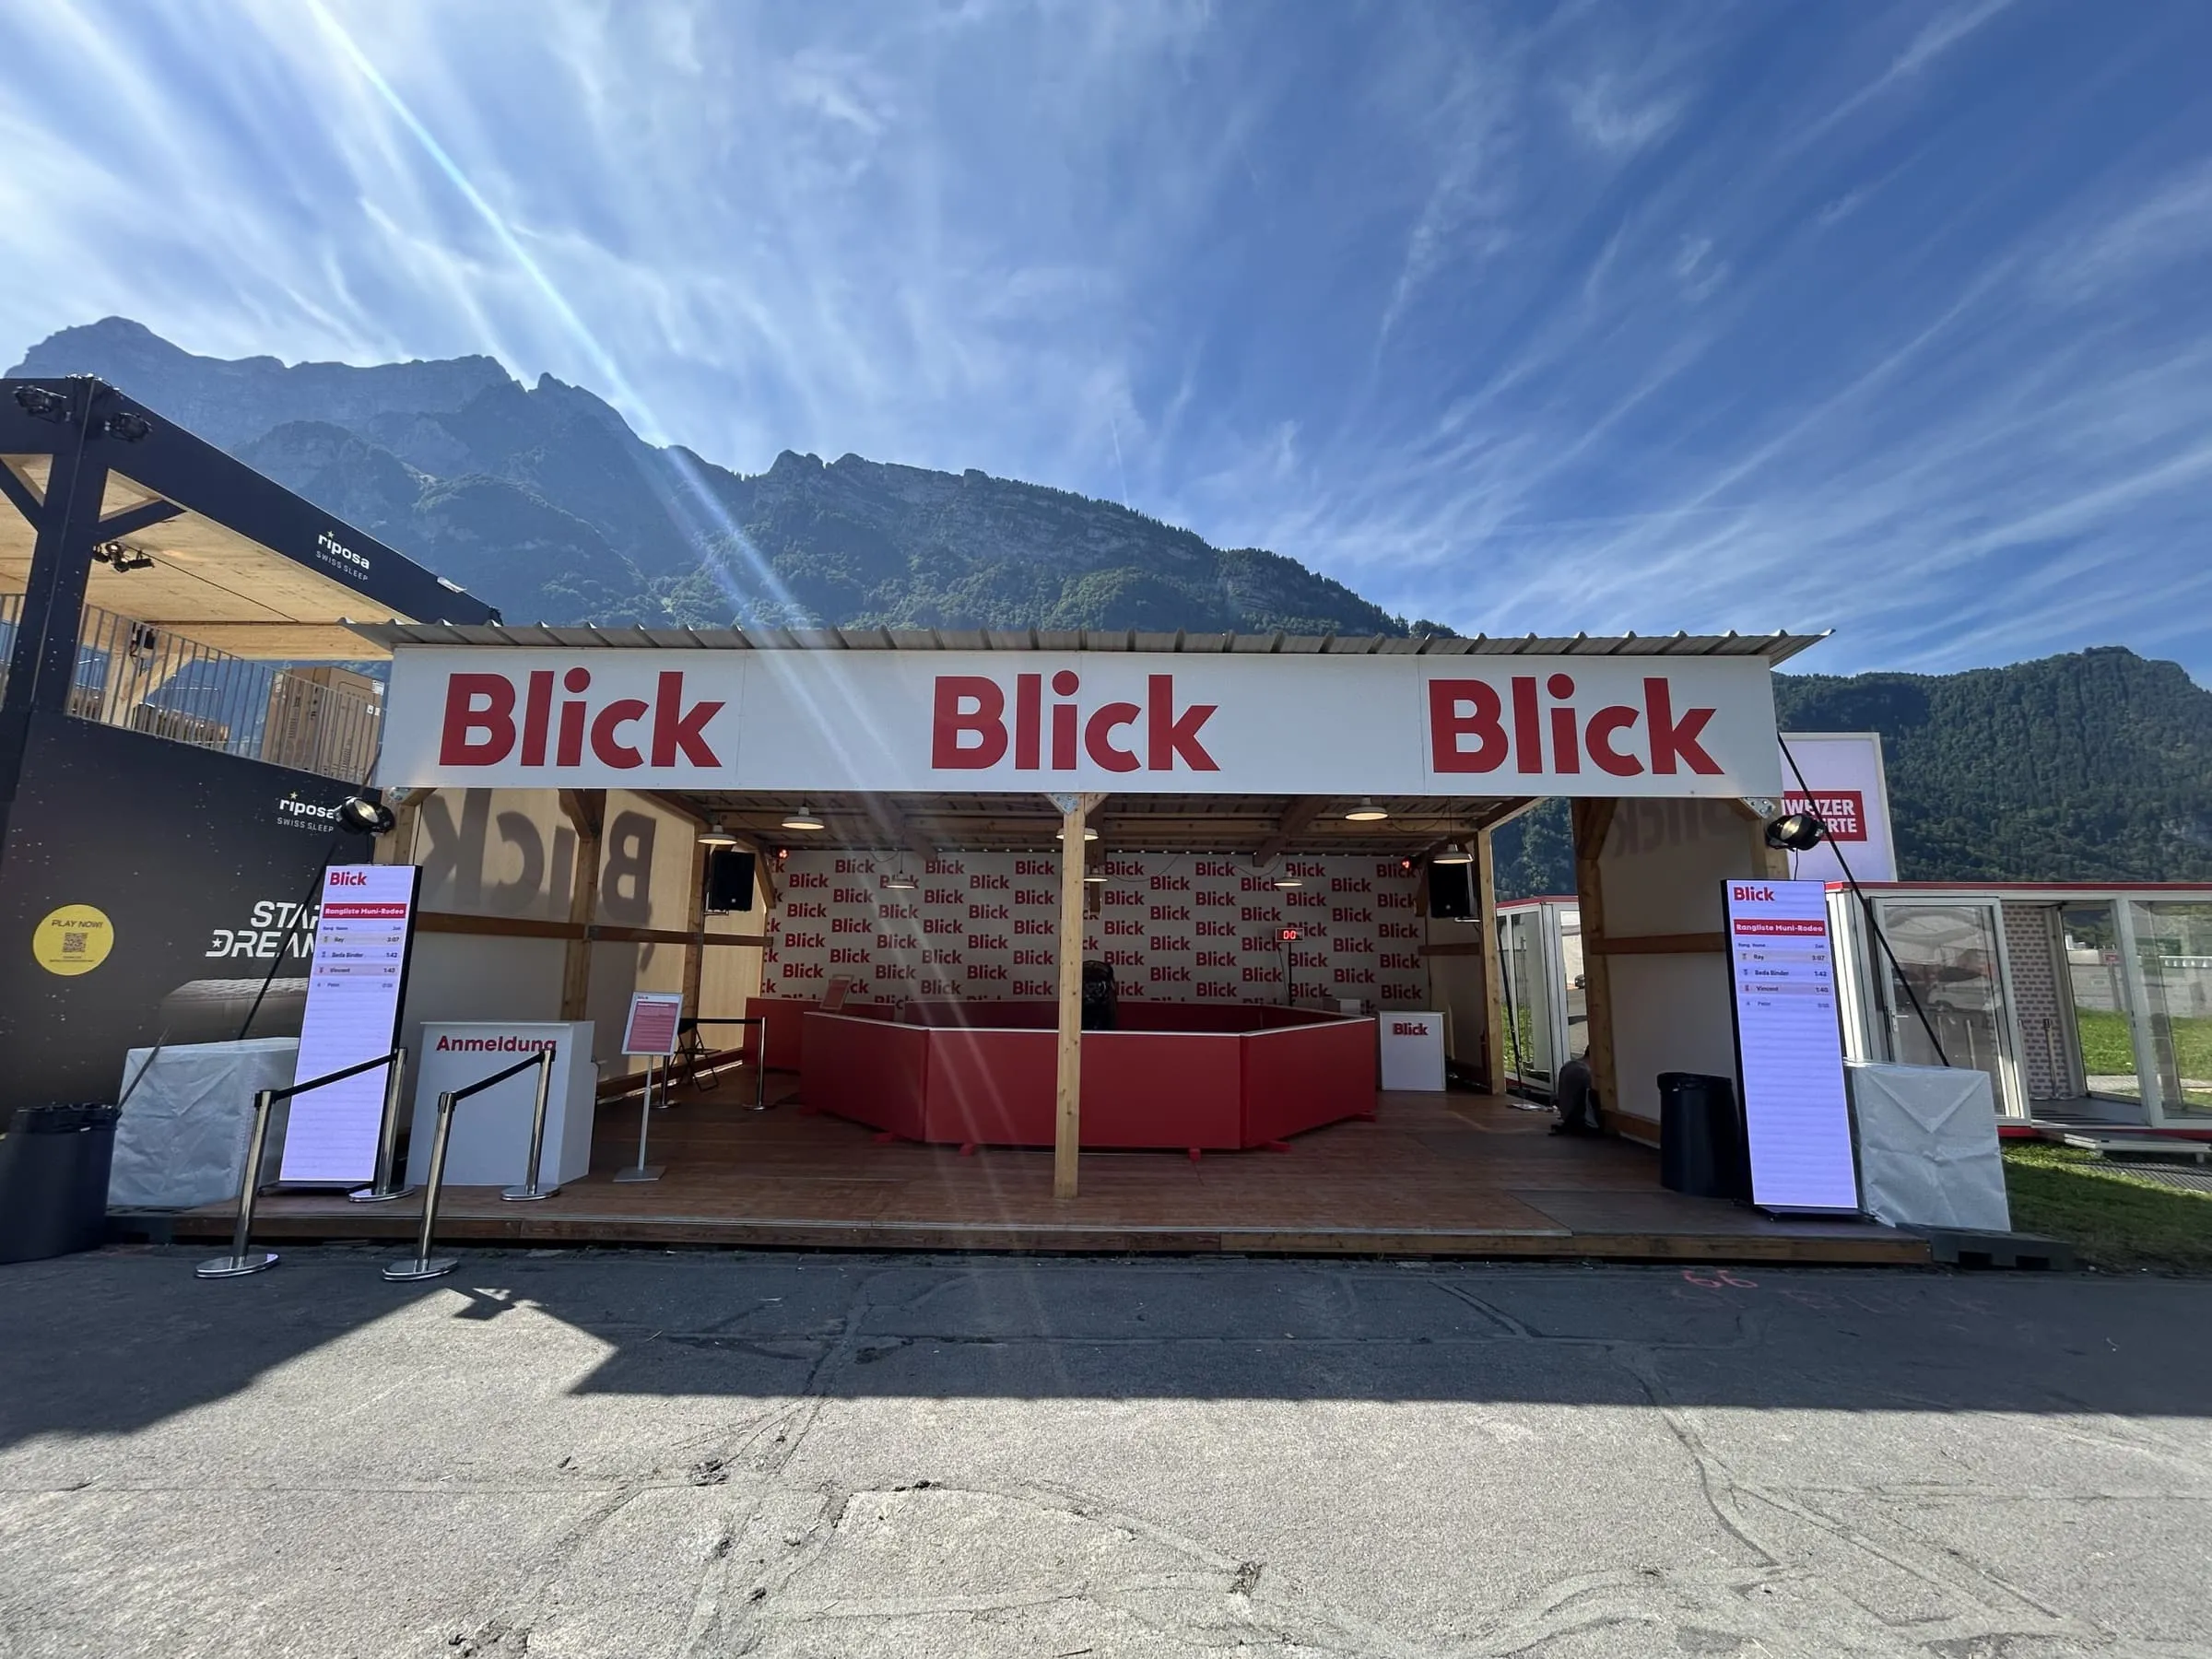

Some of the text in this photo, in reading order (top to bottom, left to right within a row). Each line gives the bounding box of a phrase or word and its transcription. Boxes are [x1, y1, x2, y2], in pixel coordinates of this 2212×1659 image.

[318, 531, 370, 570] riposa
[315, 550, 369, 581] SWISS SLEEP
[440, 667, 725, 769] Blick
[932, 670, 1220, 772] Blick
[1429, 673, 1725, 776] Blick
[276, 817, 334, 832] SWISS SLEEP
[1822, 818, 1858, 833] RTE
[835, 860, 875, 873] Blick
[925, 860, 965, 874] Blick
[1015, 860, 1054, 875] Blick
[1105, 861, 1145, 876] Blick
[1195, 862, 1236, 877] Blick
[330, 872, 367, 886] Blick
[790, 874, 829, 888] Blick
[970, 875, 1009, 889] Blick
[1150, 876, 1190, 890] Blick
[1332, 878, 1371, 892] Blick
[833, 888, 874, 903] Blick
[924, 889, 964, 904] Blick
[1015, 889, 1054, 904] Blick
[1104, 890, 1145, 905] Blick
[1195, 891, 1236, 906] Blick
[1287, 892, 1326, 907] Blick
[1734, 887, 1775, 901] Blick
[787, 903, 827, 918] Blick
[879, 904, 919, 919] Blick
[969, 904, 1009, 919] Blick
[1150, 905, 1190, 921] Blick
[1241, 907, 1281, 922] Blick
[1332, 908, 1372, 923] Blick
[52, 920, 76, 928] PLAY
[832, 919, 872, 933] Blick
[924, 919, 963, 934] Blick
[1014, 920, 1054, 935] Blick
[1104, 921, 1145, 935] Blick
[1195, 921, 1236, 935] Blick
[1379, 924, 1418, 938] Blick
[785, 933, 826, 947] Blick
[877, 934, 917, 948] Blick
[969, 935, 1008, 949] Blick
[1150, 935, 1191, 950] Blick
[1334, 938, 1374, 953] Blick
[830, 948, 870, 963] Blick
[922, 949, 962, 964] Blick
[1014, 950, 1053, 965] Blick
[1104, 951, 1145, 966] Blick
[1195, 951, 1237, 967] Blick
[1288, 952, 1327, 968] Blick
[1380, 953, 1420, 969] Blick
[783, 963, 824, 978] Blick
[876, 964, 916, 979] Blick
[968, 964, 1008, 980] Blick
[1150, 967, 1191, 982] Blick
[1242, 967, 1283, 982] Blick
[1334, 969, 1375, 983] Blick
[921, 980, 961, 994] Blick
[1013, 981, 1053, 995] Blick
[1114, 981, 1145, 996] lick
[1196, 982, 1237, 997] Blick
[1288, 983, 1329, 998] Blick
[1381, 984, 1422, 1000] Blick
[1393, 1023, 1429, 1036] Blick
[436, 1035, 557, 1053] Anmeldung
